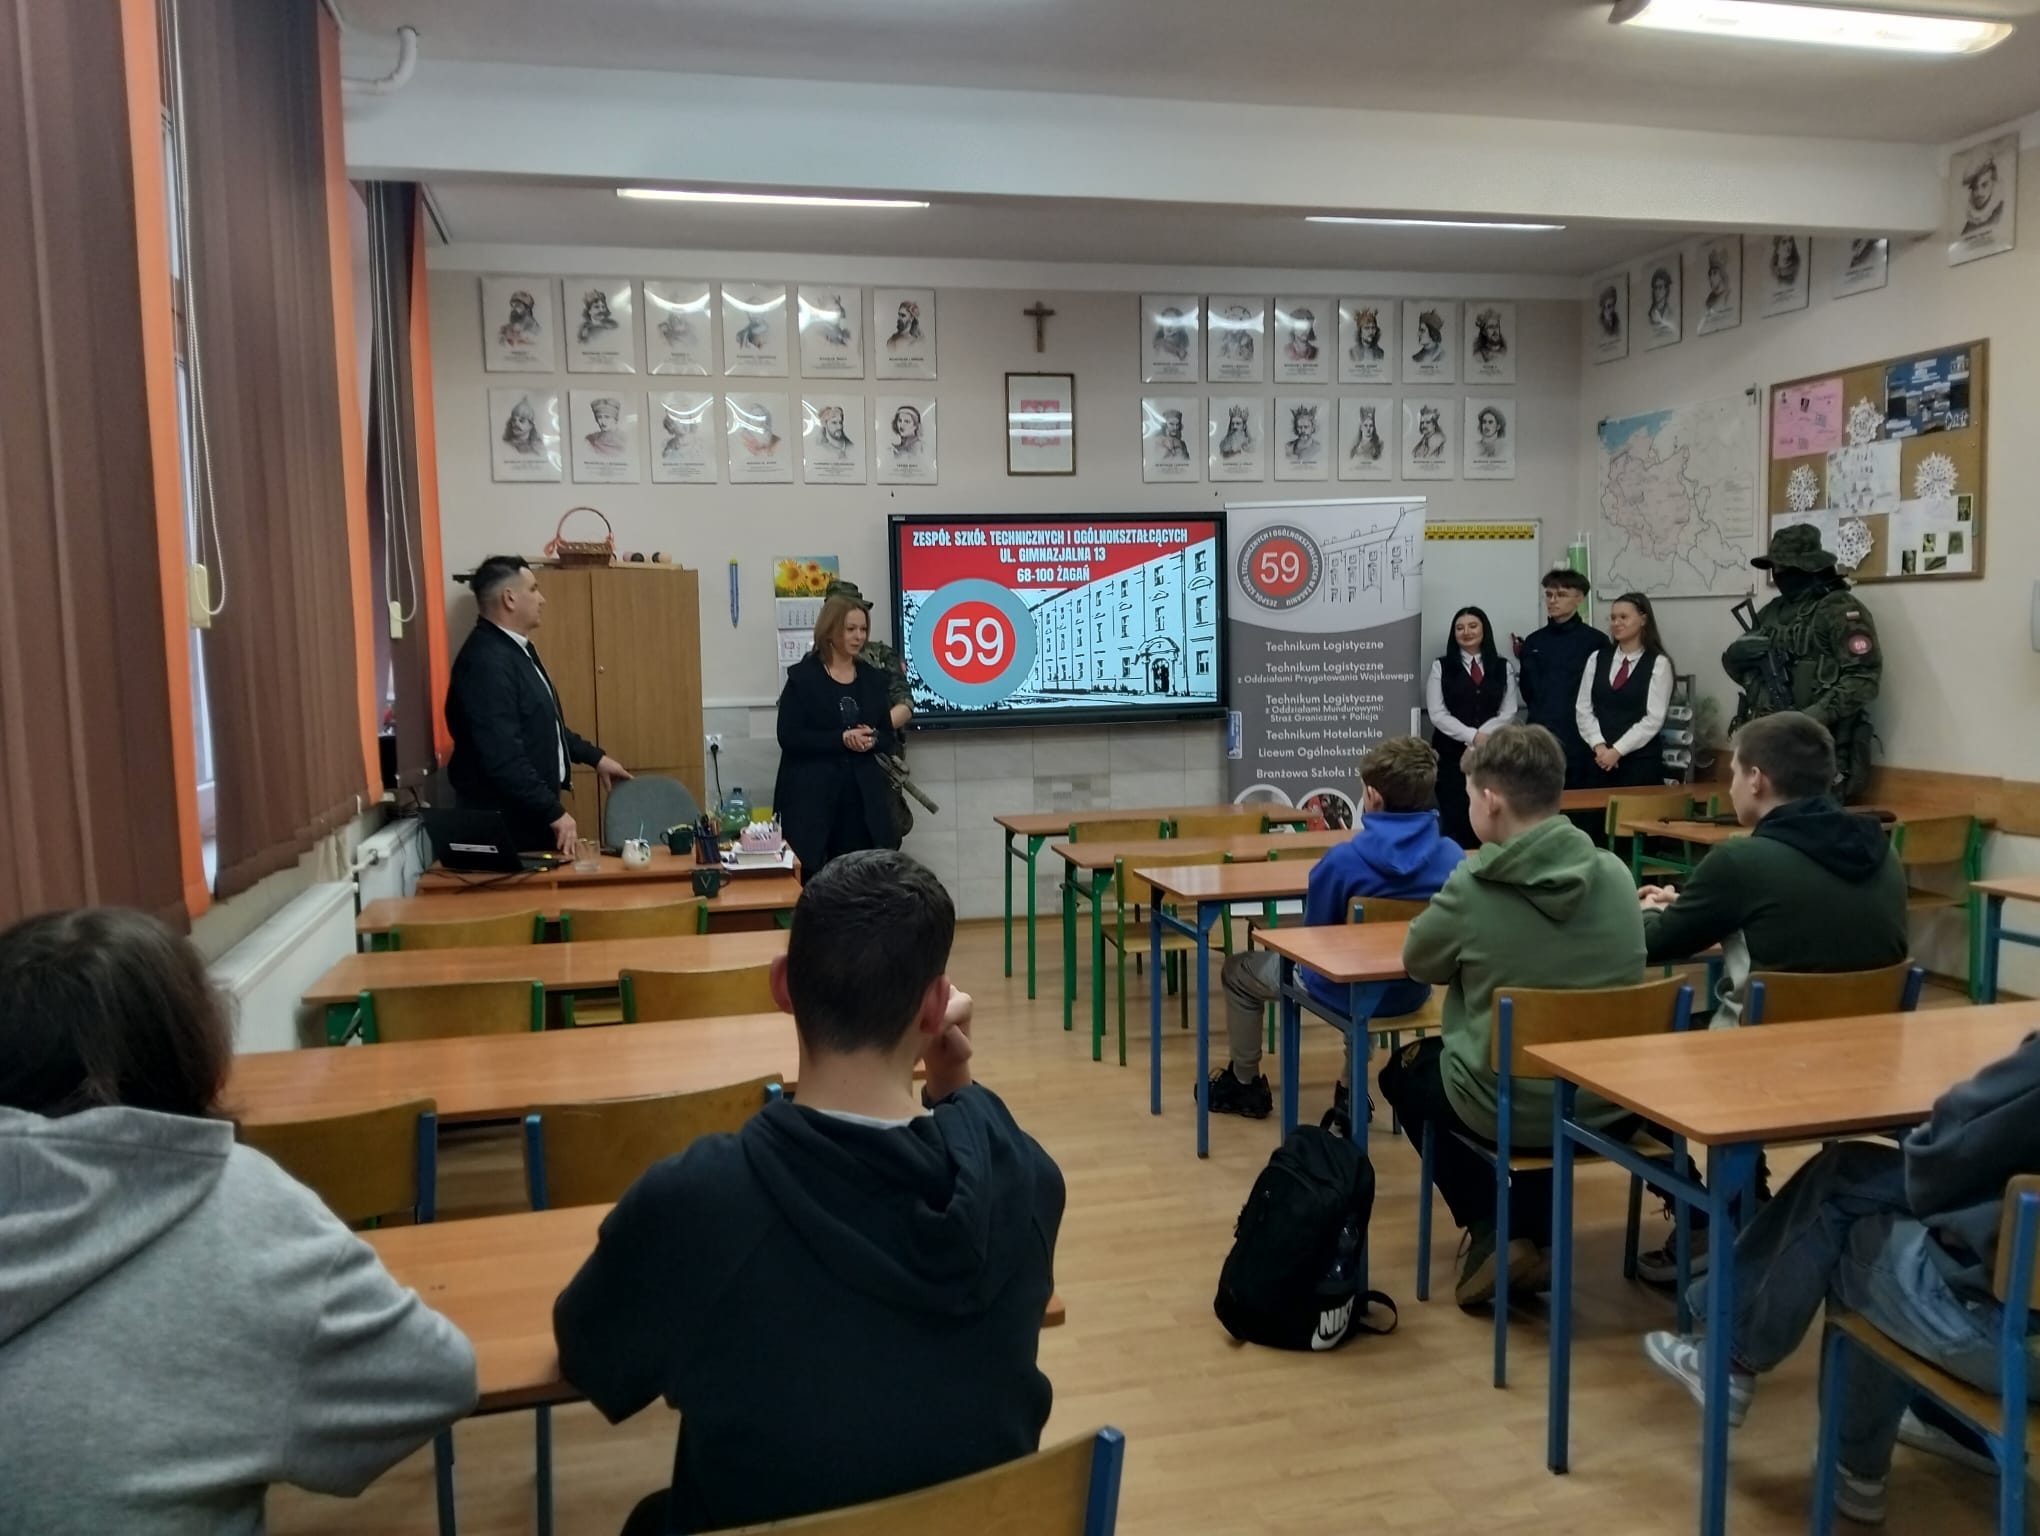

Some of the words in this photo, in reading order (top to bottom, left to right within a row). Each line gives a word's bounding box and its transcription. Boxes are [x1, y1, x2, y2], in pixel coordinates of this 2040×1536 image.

[912, 528, 952, 546] ZESPÓŁ
[954, 528, 987, 546] SZKÓŁ
[990, 529, 1064, 546] TECHNICZNYCH
[1067, 530, 1071, 544] I
[1074, 527, 1188, 548] OGÓLNOKSZTAŁCĄCYCH
[1000, 548, 1016, 563] UL.
[1018, 547, 1091, 562] GIMNAZJALNA
[1094, 546, 1106, 562] 13
[1016, 568, 1054, 582] 68-100
[1056, 564, 1090, 582] ŻAGAŃ
[1260, 551, 1300, 584] 59
[944, 617, 1004, 667] 59
[1266, 640, 1320, 652] Technikum
[1323, 640, 1384, 653] Logistyczne
[1266, 662, 1320, 674] Technikum
[1323, 662, 1384, 675] Logistyczne
[1244, 674, 1292, 684] Oddziałami
[1295, 674, 1358, 684] Przygotowania
[1360, 672, 1414, 683] Wojskowego
[1266, 693, 1320, 705] Technikum
[1323, 693, 1384, 706] Logistyczne
[1270, 713, 1292, 722] Straż
[1294, 713, 1338, 722] Graniczna
[1350, 712, 1378, 722] Policja
[1266, 728, 1320, 740] Technikum
[1323, 727, 1384, 739] Hotelarskie
[1258, 748, 1294, 758] Liceum
[1256, 768, 1308, 778] Branżowa
[1311, 766, 1346, 778] Szkoła
[1320, 1304, 1351, 1336] NIK
